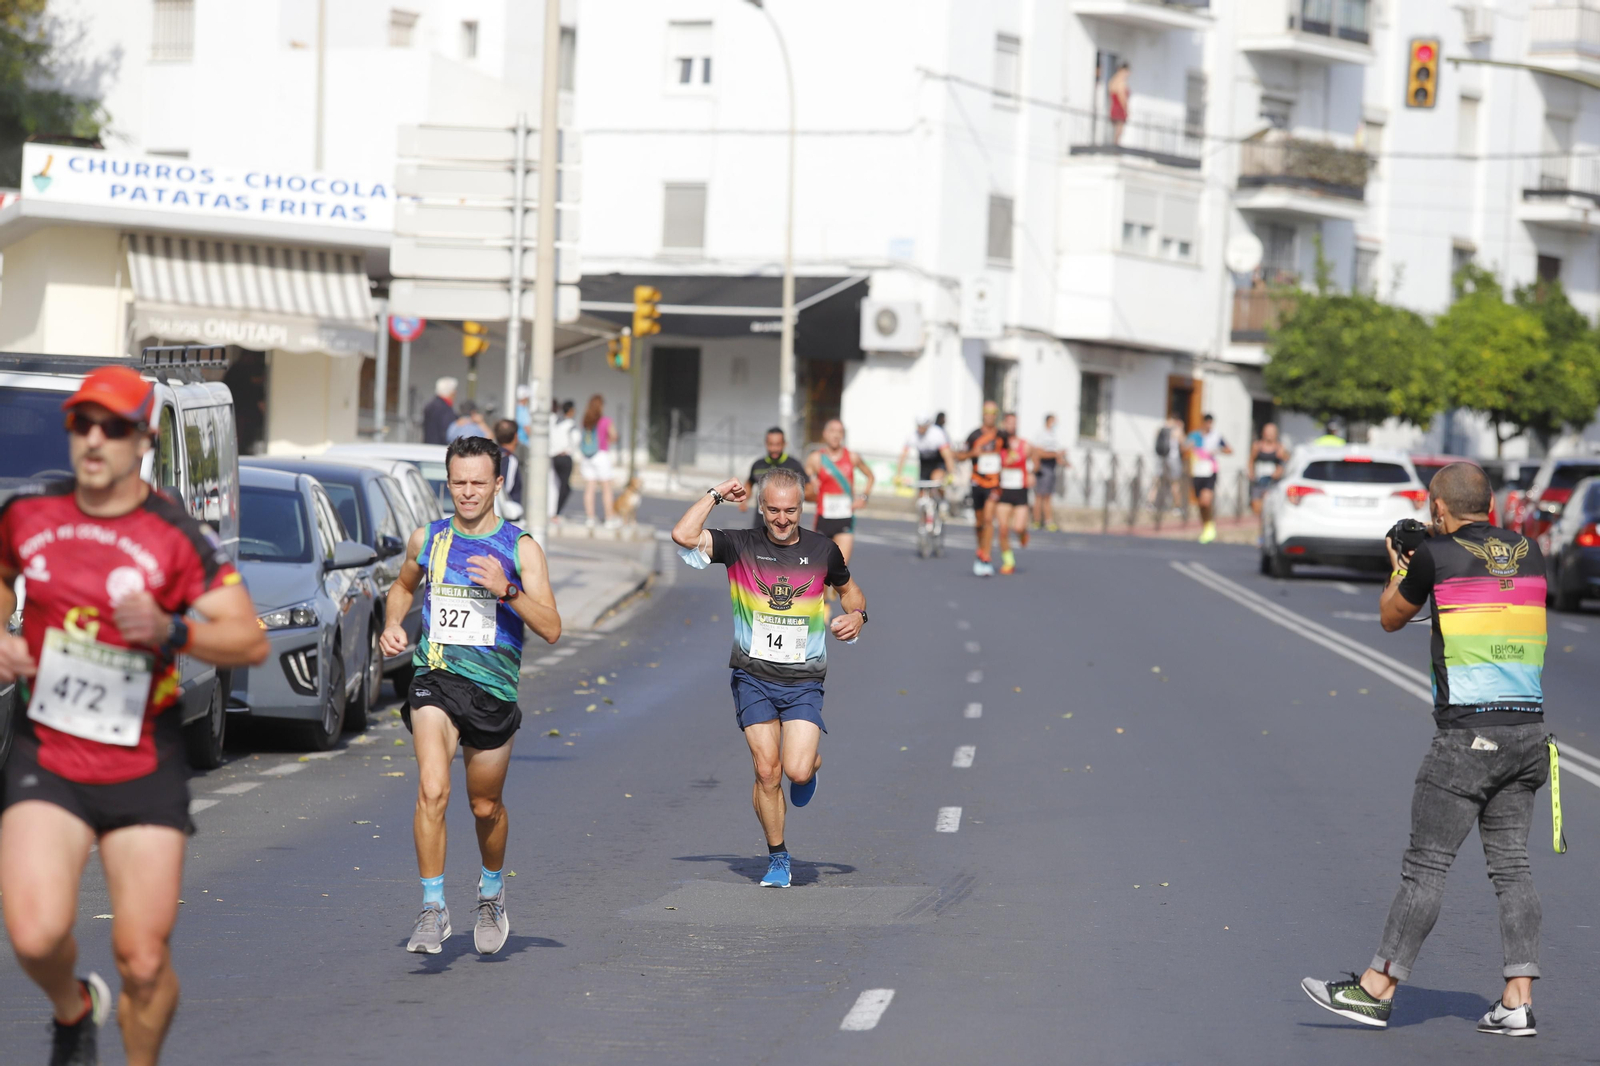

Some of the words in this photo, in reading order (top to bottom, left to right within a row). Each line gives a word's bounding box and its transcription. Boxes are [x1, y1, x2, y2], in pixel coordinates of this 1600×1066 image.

[68, 155, 215, 184] CHURROS
[245, 172, 423, 201] CHOCOLA
[110, 184, 250, 212] PATATAS
[261, 198, 367, 222] FRITAS
[441, 587, 461, 597] VUELTA
[463, 589, 467, 597] A
[439, 608, 470, 628] 327
[764, 615, 781, 624] VUELTA
[766, 633, 783, 649] 14
[1490, 644, 1525, 655] IBHOLA
[53, 675, 106, 713] 472
